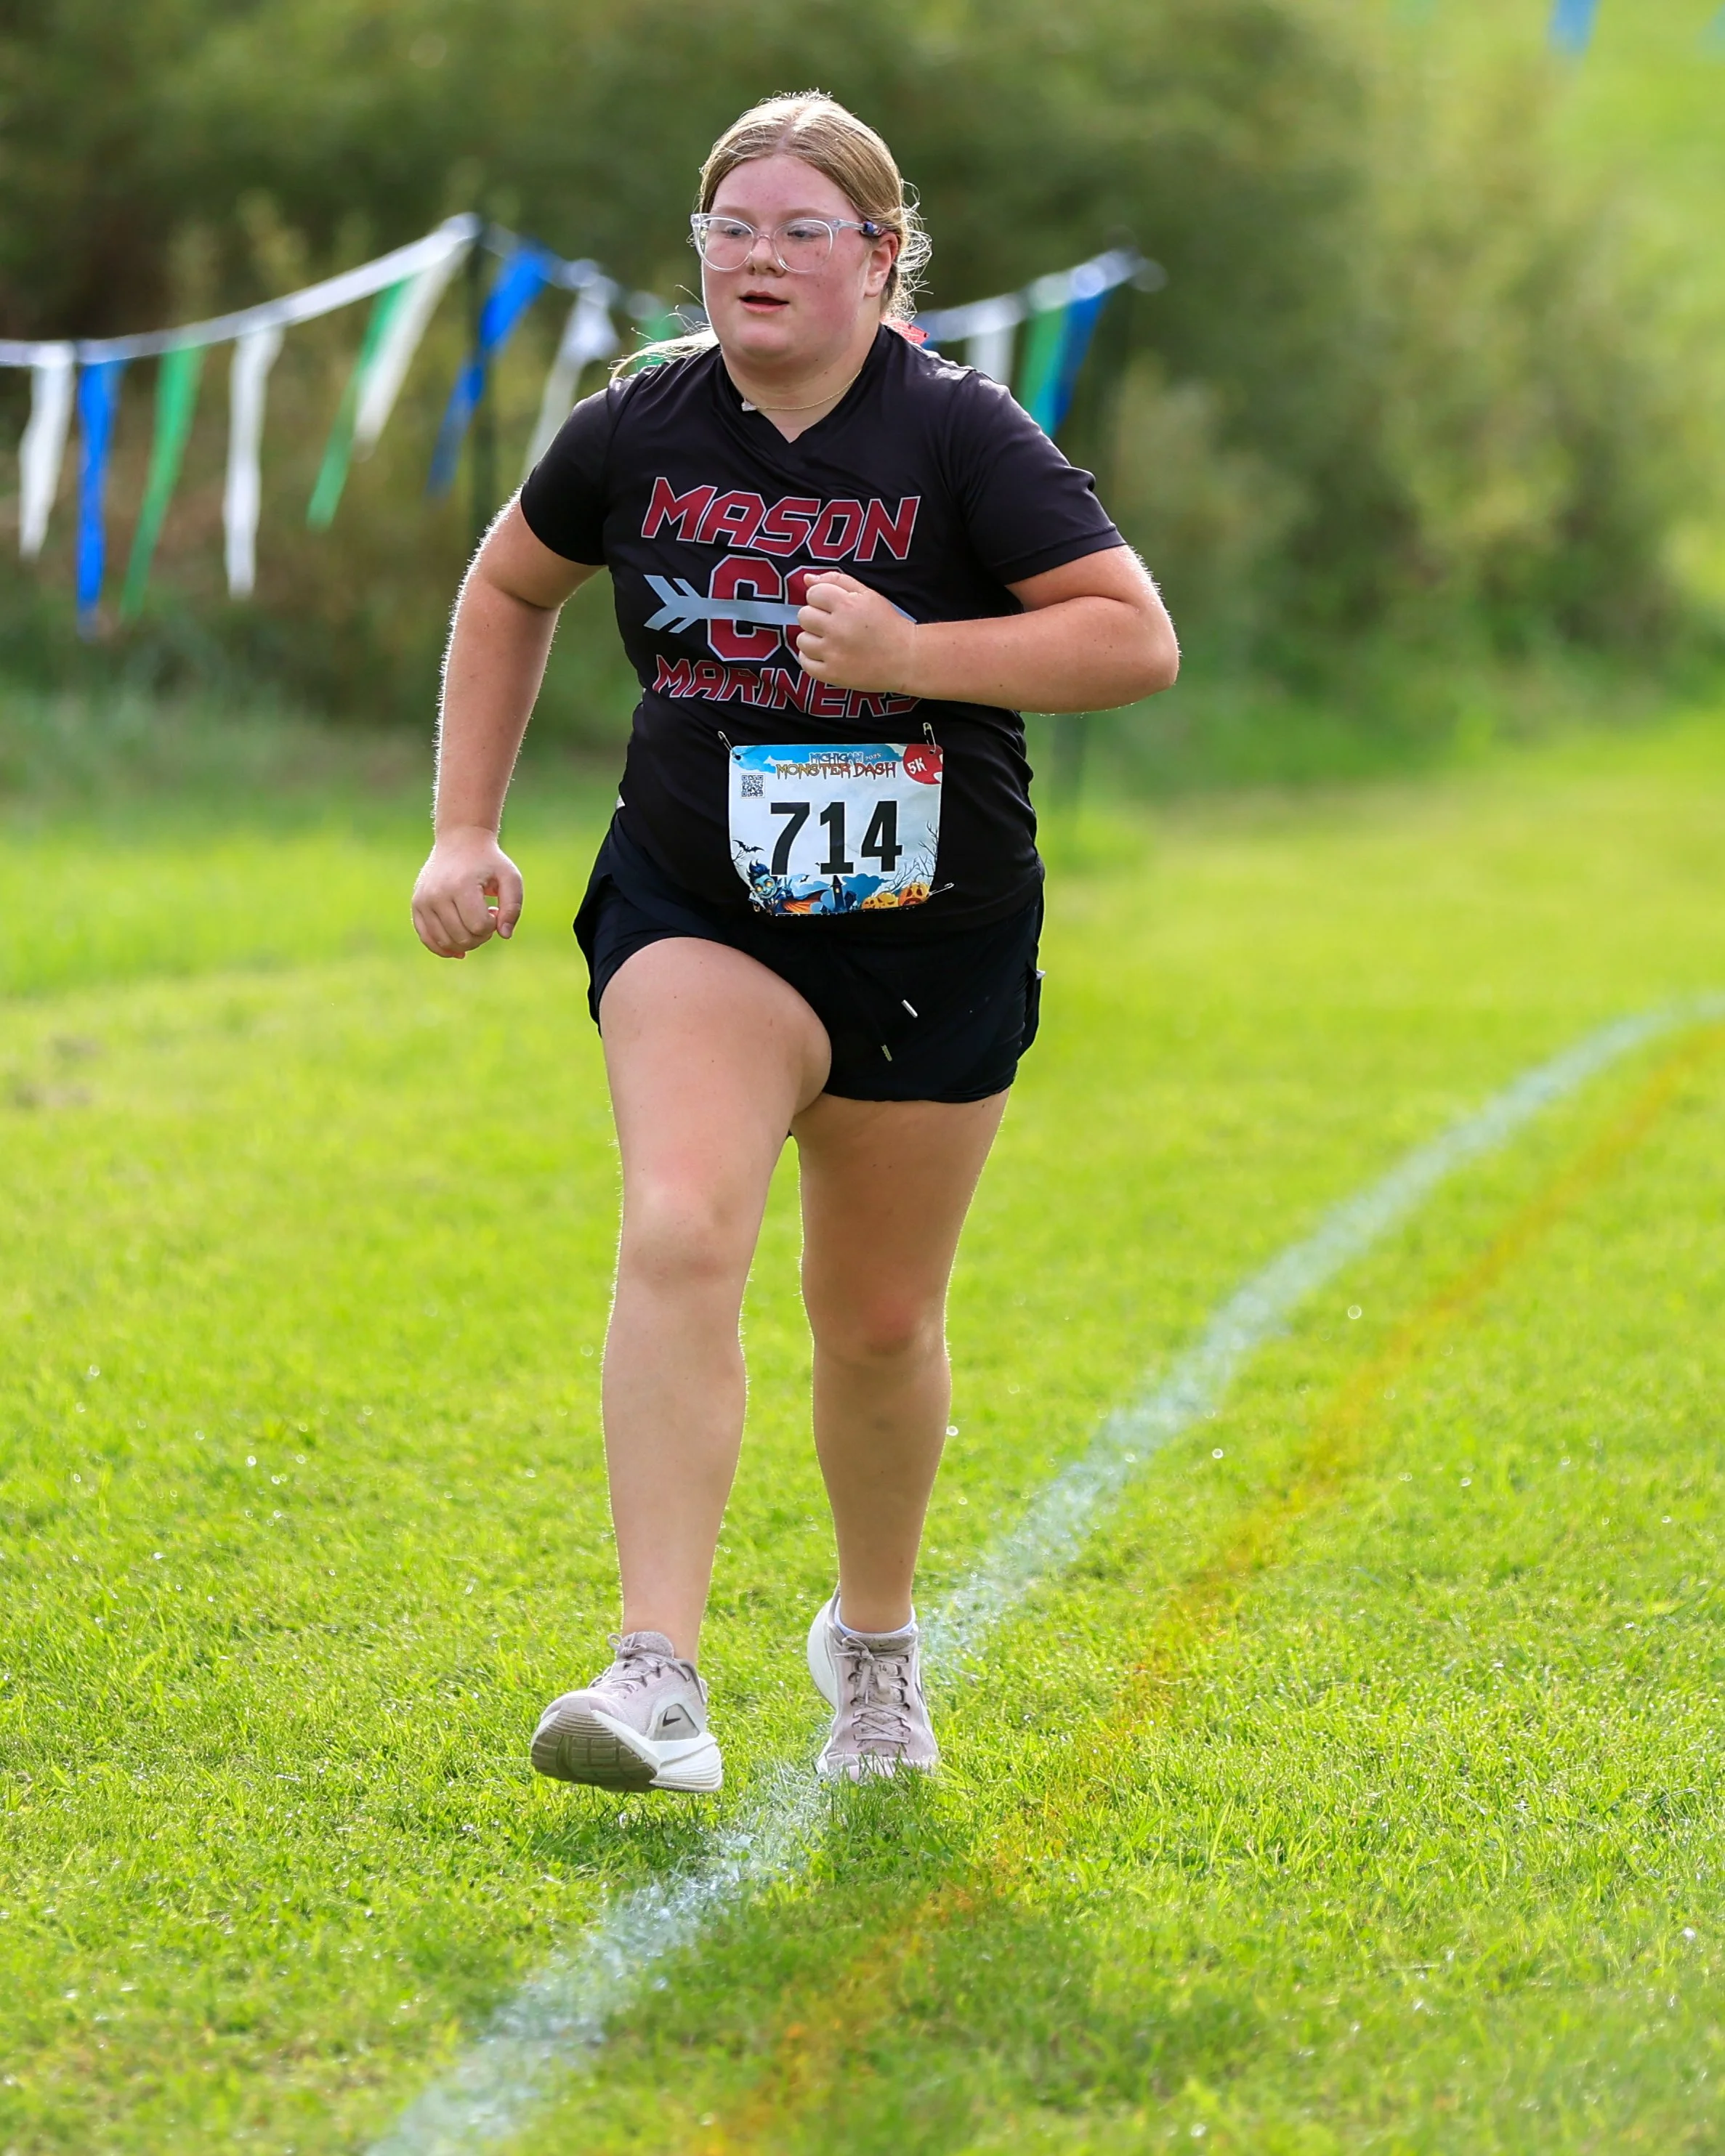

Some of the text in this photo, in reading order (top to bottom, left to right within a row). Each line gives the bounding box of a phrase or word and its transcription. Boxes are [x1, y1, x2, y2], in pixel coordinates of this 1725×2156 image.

[641, 477, 921, 562] MASON
[809, 751, 863, 763] MICHIGAN
[907, 757, 927, 774] 5K
[776, 761, 896, 780] MONSTER DASH
[770, 800, 902, 875] 714
